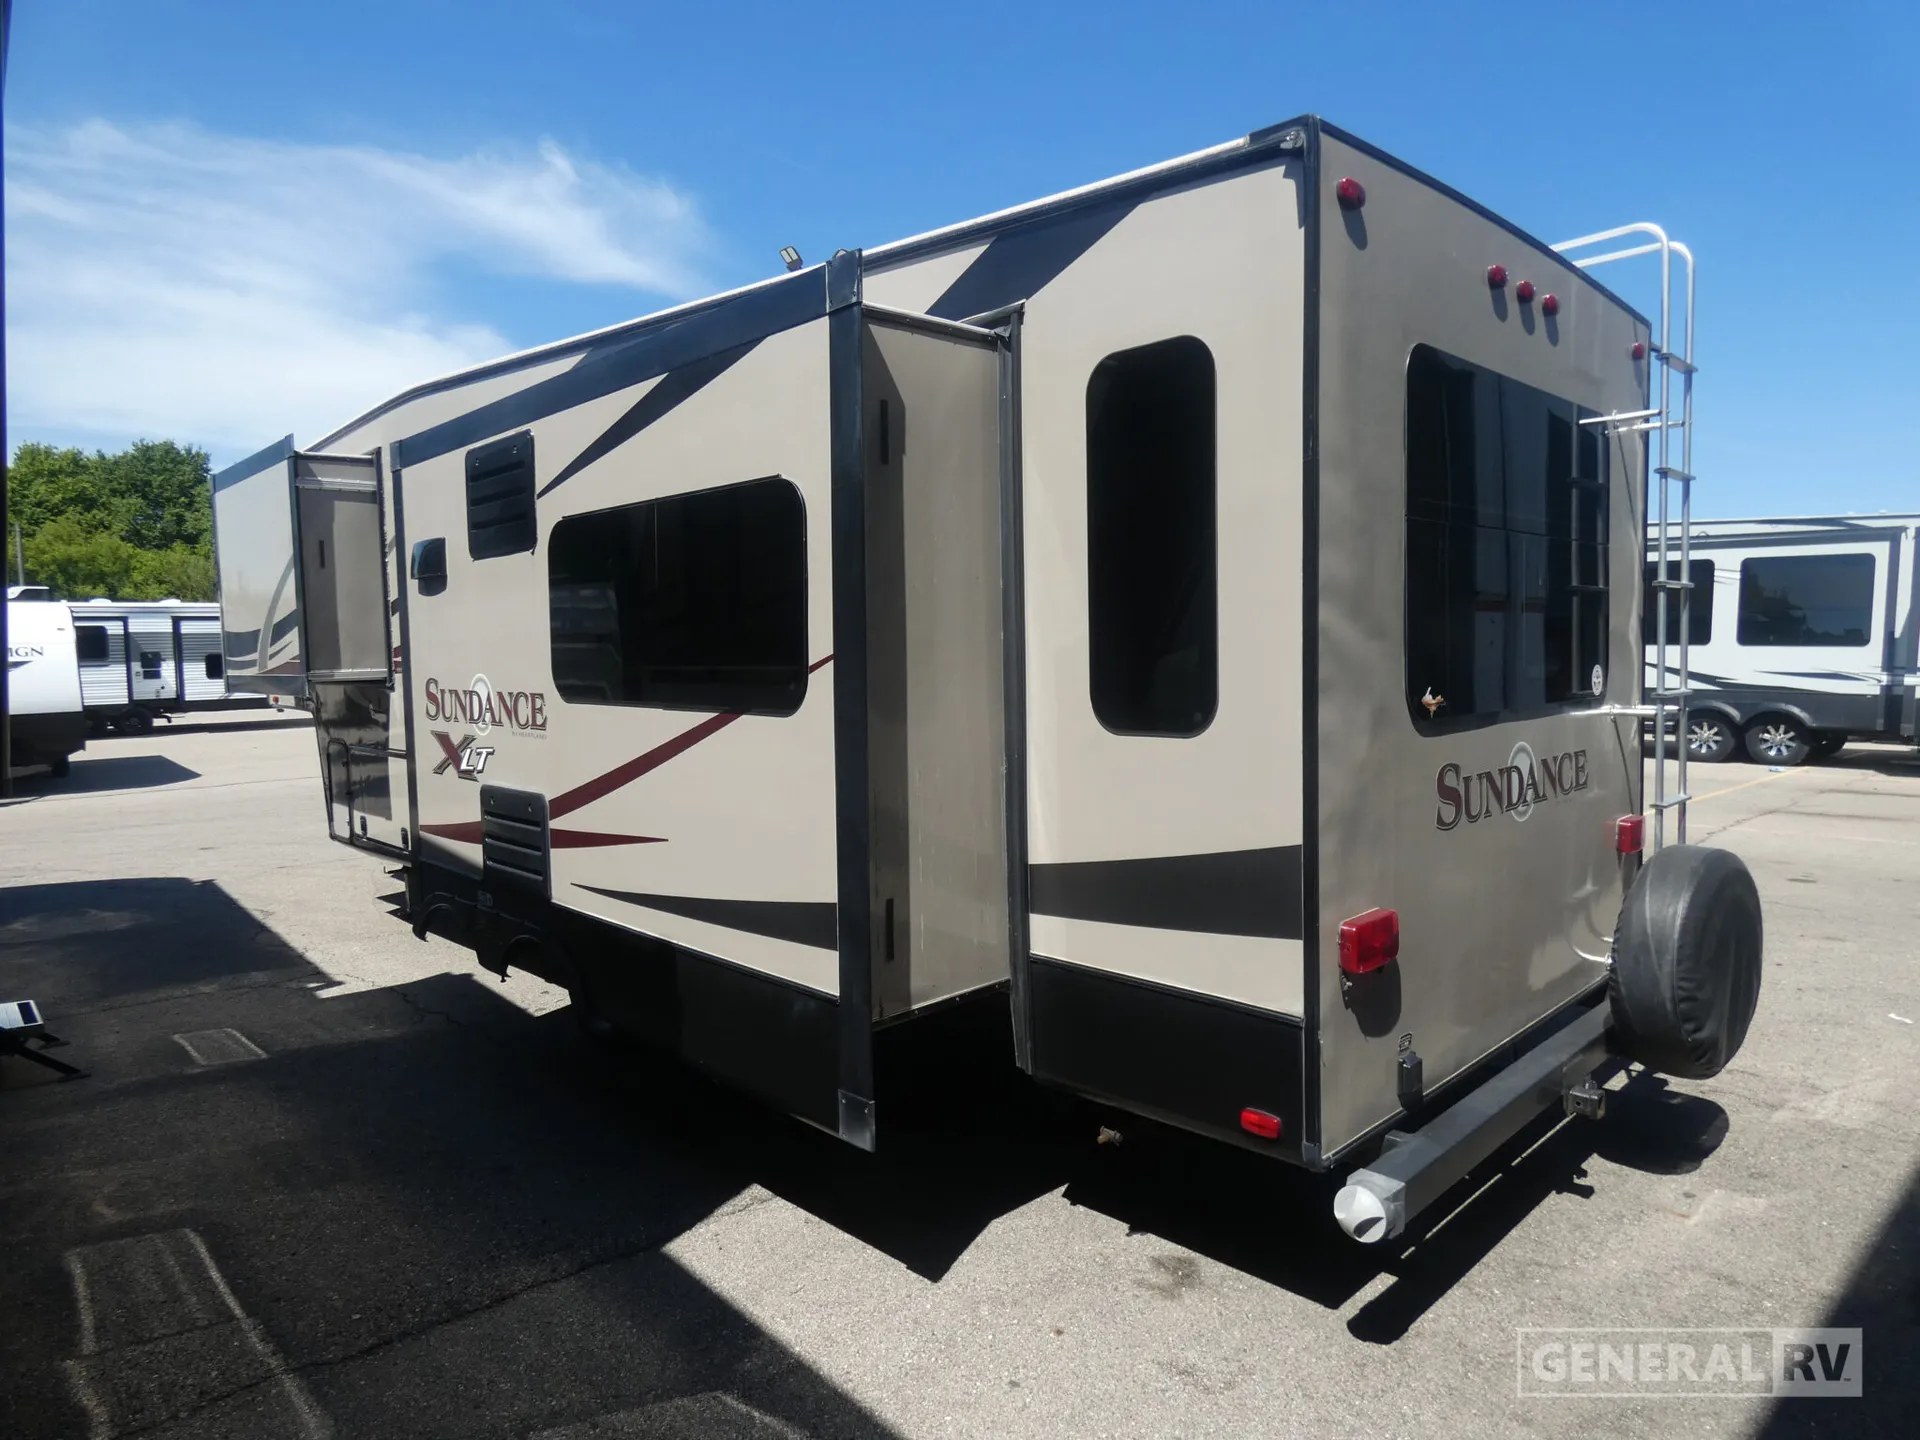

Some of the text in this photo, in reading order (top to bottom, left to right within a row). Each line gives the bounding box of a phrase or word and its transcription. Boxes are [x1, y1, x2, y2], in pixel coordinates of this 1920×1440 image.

[425, 677, 548, 730] SUNDANCE
[430, 730, 495, 782] XLT
[1435, 749, 1588, 831] SUNDANCE
